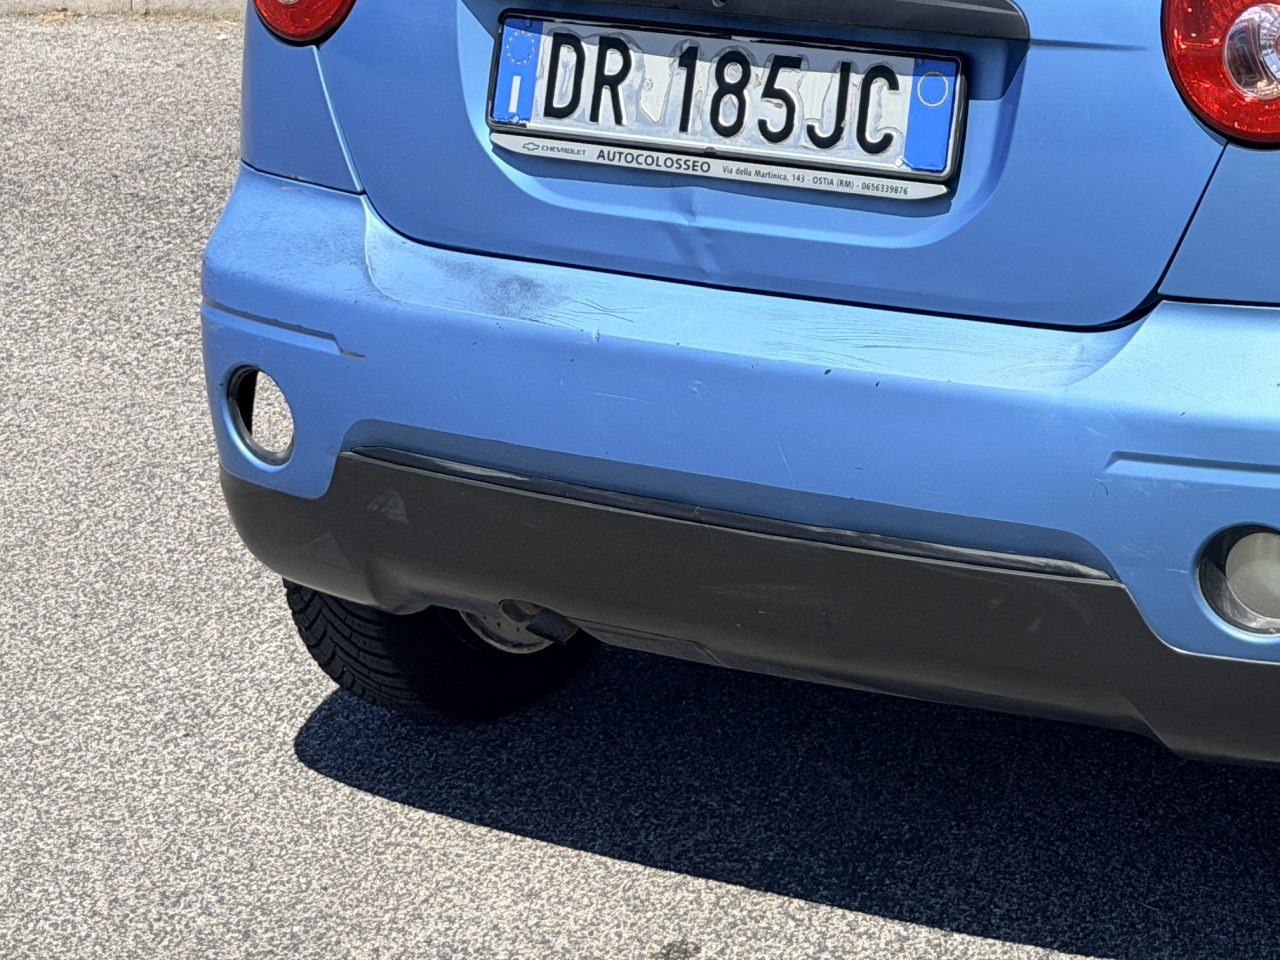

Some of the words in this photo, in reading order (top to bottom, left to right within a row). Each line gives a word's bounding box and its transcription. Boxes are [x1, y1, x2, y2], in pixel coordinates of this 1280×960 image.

[543, 31, 633, 127] DR
[541, 144, 587, 156] CHEVROLET
[596, 149, 711, 174] AUTOCOLOSSEO
[722, 165, 734, 175] Via
[735, 167, 752, 177] della
[754, 169, 790, 183] Martinica,
[792, 174, 805, 184] 143
[812, 177, 835, 187] OSTIA
[836, 179, 855, 190] (RM)
